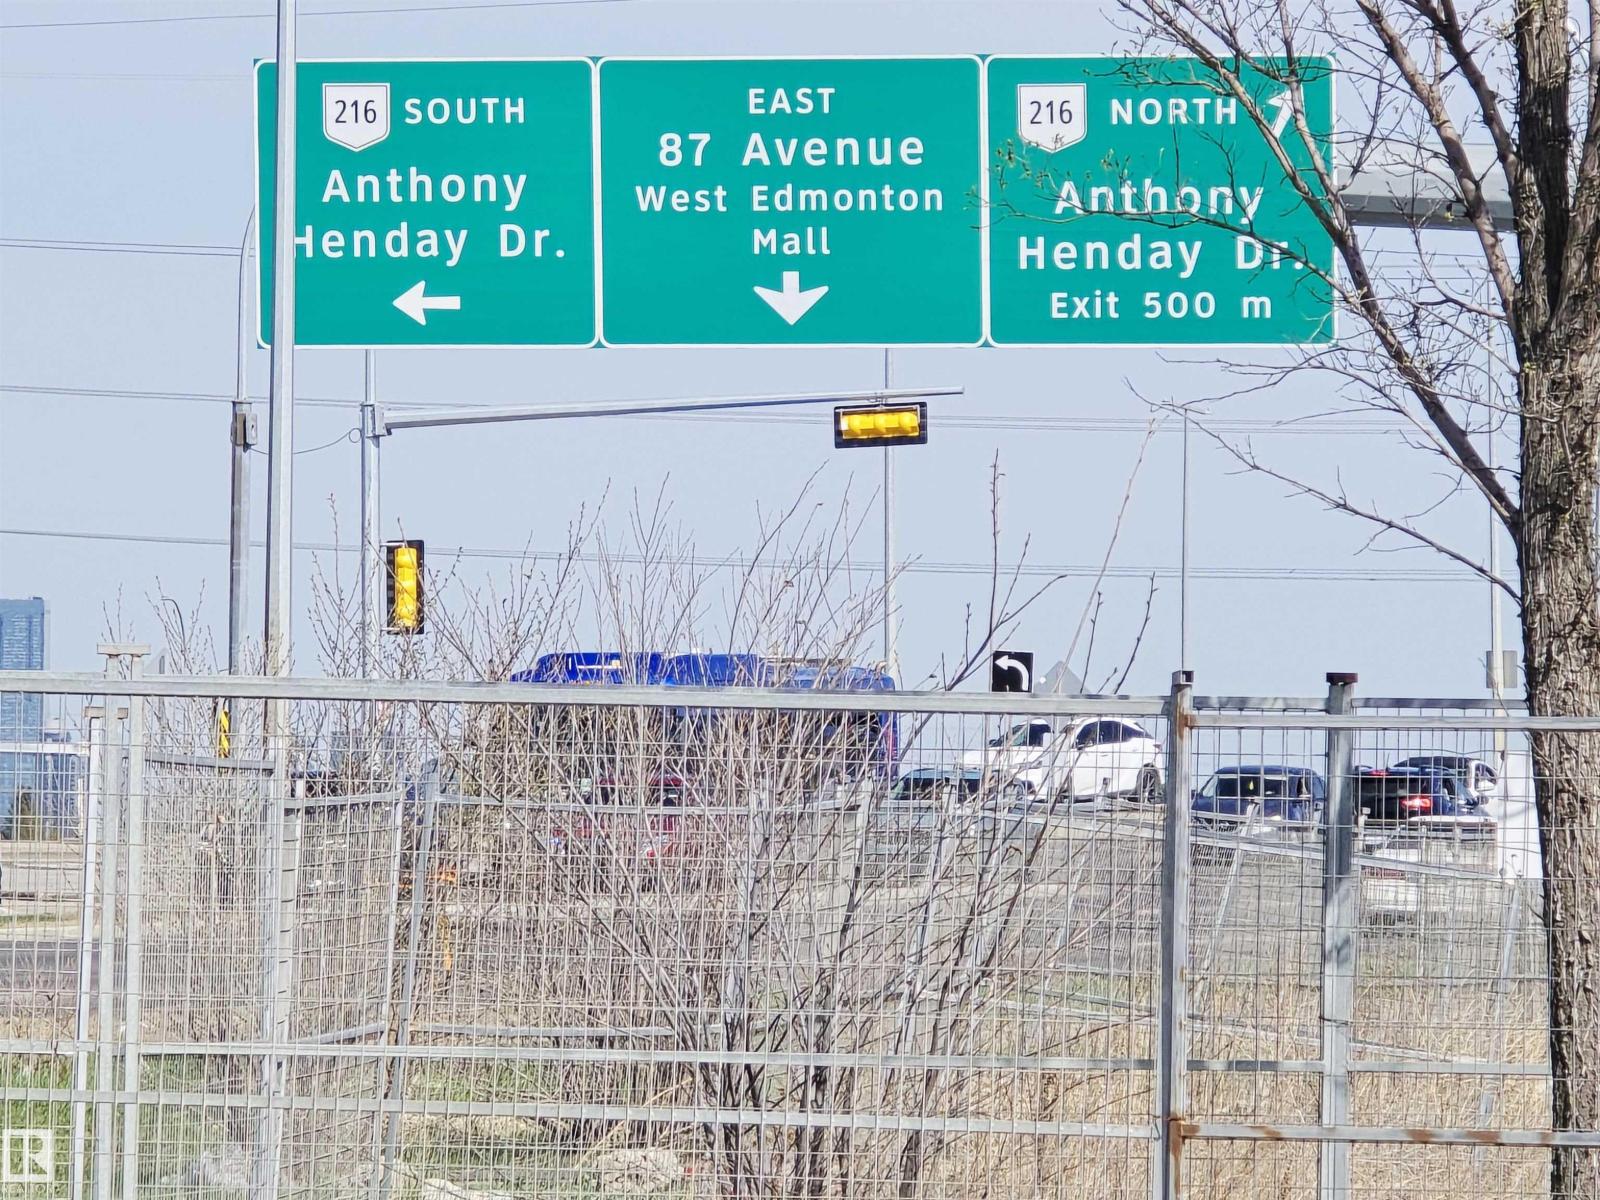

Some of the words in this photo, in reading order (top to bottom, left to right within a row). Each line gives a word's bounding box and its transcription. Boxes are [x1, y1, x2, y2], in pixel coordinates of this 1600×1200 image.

[335, 99, 377, 124] 216
[404, 97, 525, 124] SOUTH
[748, 87, 836, 115] EAST
[1030, 100, 1073, 125] 216
[1111, 98, 1237, 125] NORTH
[659, 132, 711, 167] 87
[742, 132, 925, 167] Avenue
[322, 166, 527, 212] Anthony
[635, 185, 728, 212] West
[752, 183, 943, 212] Edmonton
[1054, 178, 1264, 224] Anthony
[294, 222, 468, 267] Henday
[499, 223, 566, 258] Dr.
[753, 226, 831, 255] Mall
[1019, 233, 1202, 279] Henday
[1236, 235, 1304, 270] Dr.
[1051, 289, 1119, 319] Exit
[1144, 291, 1216, 319] 500
[1242, 296, 1272, 319] m
